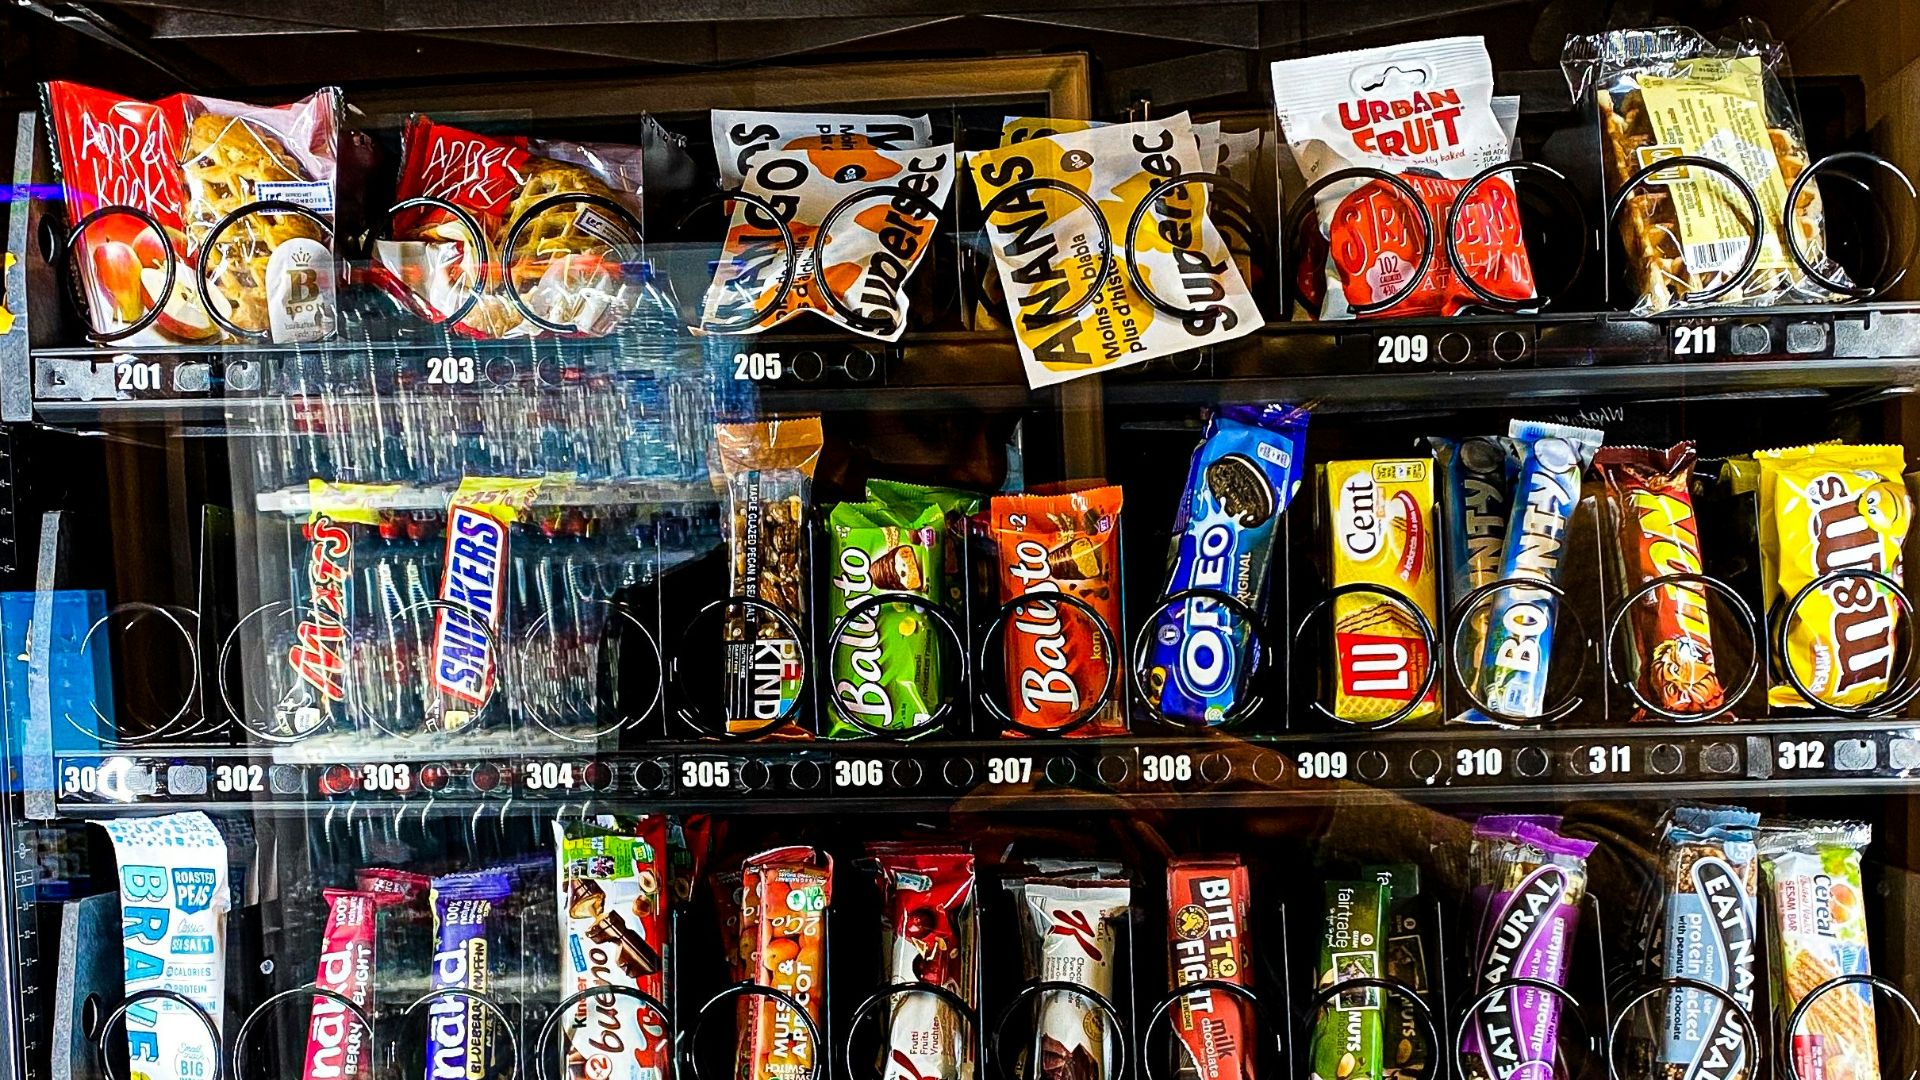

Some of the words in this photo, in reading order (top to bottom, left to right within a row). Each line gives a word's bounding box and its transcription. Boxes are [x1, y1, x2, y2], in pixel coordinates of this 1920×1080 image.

[1338, 88, 1462, 130] URBAN
[840, 124, 854, 150] Moin
[1352, 110, 1463, 157] FRUIT
[1440, 148, 1466, 161] baked
[980, 155, 1093, 365] ANANAS
[1072, 232, 1097, 283] blabla
[1379, 255, 1400, 276] 102
[1420, 274, 1450, 292] AT
[1097, 304, 1121, 361] Moins
[1122, 315, 1147, 354] plus
[1674, 325, 1716, 355] 211
[1378, 335, 1429, 364] 209
[117, 362, 162, 391] 201
[426, 357, 476, 385] 203
[733, 352, 782, 381] 205
[748, 484, 758, 512] MAPLE
[748, 512, 758, 545] GLAZED
[1346, 480, 1375, 554] Cent
[747, 546, 757, 575] PECAN
[1494, 471, 1572, 673] BOUNTY
[1629, 488, 1712, 647] LION
[747, 576, 757, 584] &
[1235, 551, 1252, 603] RIGINAL
[440, 512, 503, 694] SNICKERS
[1186, 525, 1234, 687] OREO
[1089, 629, 1102, 660] korn
[754, 639, 780, 720] KIND
[1351, 642, 1409, 692] LU
[987, 757, 1033, 784] 307
[1143, 754, 1192, 782] 308
[1297, 751, 1348, 779] 309
[1456, 747, 1503, 777] 310
[1588, 745, 1631, 773] 311
[1778, 741, 1825, 770] 312
[216, 765, 264, 792] 302
[363, 764, 410, 791] 303
[526, 762, 574, 790] 304
[681, 761, 730, 787] 305
[835, 759, 884, 787] 306
[174, 870, 216, 885] ROASTED
[177, 884, 212, 907] PEAS
[1199, 878, 1237, 941] BITE
[1704, 874, 1744, 930] EAT
[1785, 880, 1796, 911] SESAM
[335, 896, 348, 927] 100%
[445, 900, 463, 927] 100%
[1677, 915, 1686, 936] with
[1786, 913, 1798, 932] BAR
[182, 937, 212, 952] SALT
[1351, 930, 1360, 949] OXFAM
[1484, 876, 1559, 1014] NATURAL
[1676, 936, 1685, 974] peanuts
[1687, 913, 1703, 975] protein
[120, 864, 172, 1064] BRAVE
[173, 965, 212, 978] CALORIES
[352, 944, 372, 1010] ELIGHT
[472, 941, 486, 990] MUFFIN
[778, 959, 795, 976] &
[1175, 939, 1216, 1014] FIGHT
[1179, 970, 1188, 984] FOR
[1522, 986, 1534, 1009] fruit
[1531, 948, 1542, 962] bar
[173, 983, 208, 995] PROTEIN
[588, 946, 625, 1053] bueno
[1530, 990, 1552, 1053] almond
[1544, 917, 1565, 974] sultana
[773, 984, 791, 1059] MUESI
[791, 961, 812, 1060] APRCOT
[1181, 1003, 1192, 1029] INCOME
[1673, 994, 1683, 1041] chocolate
[1685, 988, 1702, 1042] acked
[909, 1030, 920, 1055] Frutti
[919, 1030, 929, 1055] Fruits
[929, 1016, 940, 1056] Vruchten
[1210, 1018, 1236, 1060] milk
[1346, 1010, 1362, 1052] NUTS
[344, 1020, 363, 1075] BERRY
[1200, 1016, 1219, 1079] chocolate
[1487, 1022, 1521, 1080] EAT
[180, 1061, 204, 1077] BIG
[764, 1063, 805, 1074] SWITCH
